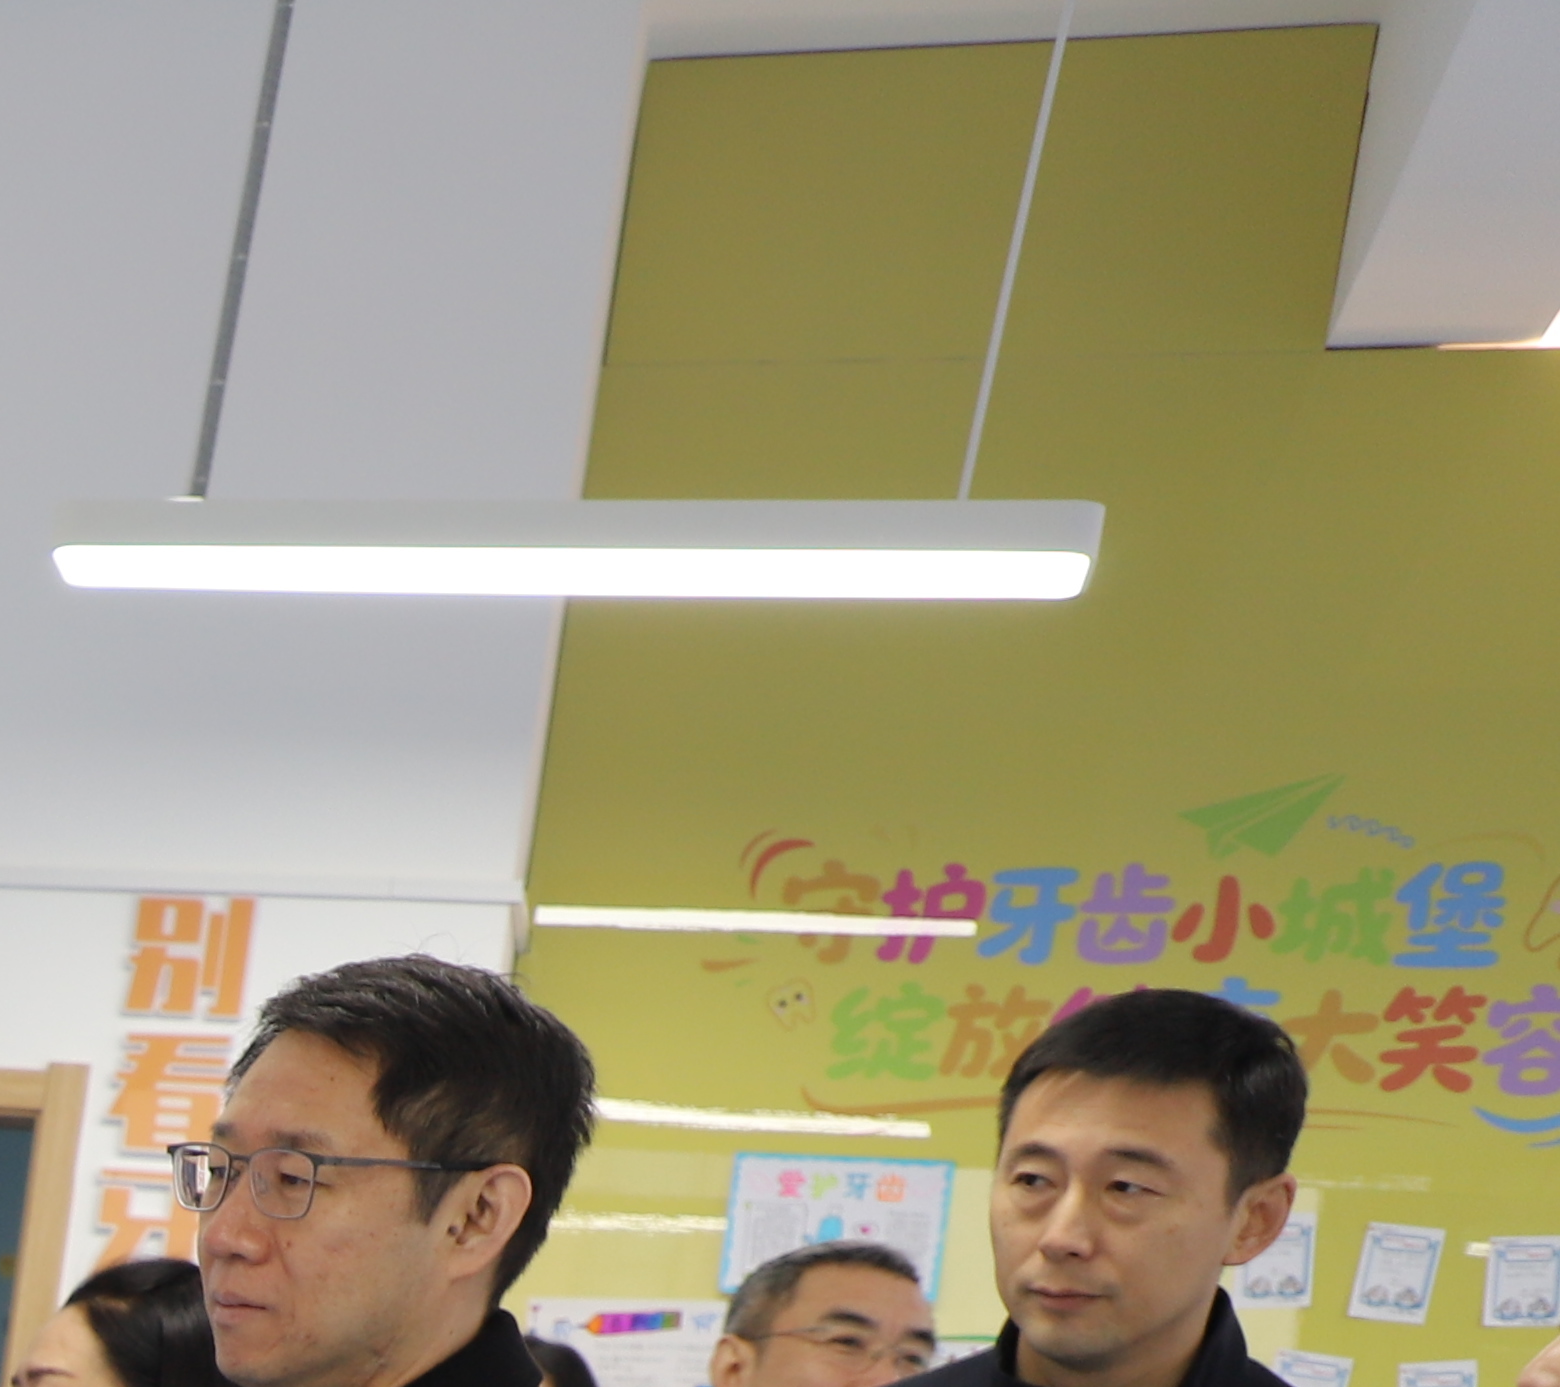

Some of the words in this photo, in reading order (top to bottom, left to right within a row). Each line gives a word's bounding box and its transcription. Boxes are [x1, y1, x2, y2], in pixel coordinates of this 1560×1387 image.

[782, 860, 1507, 969] 守护牙齿小城堡
